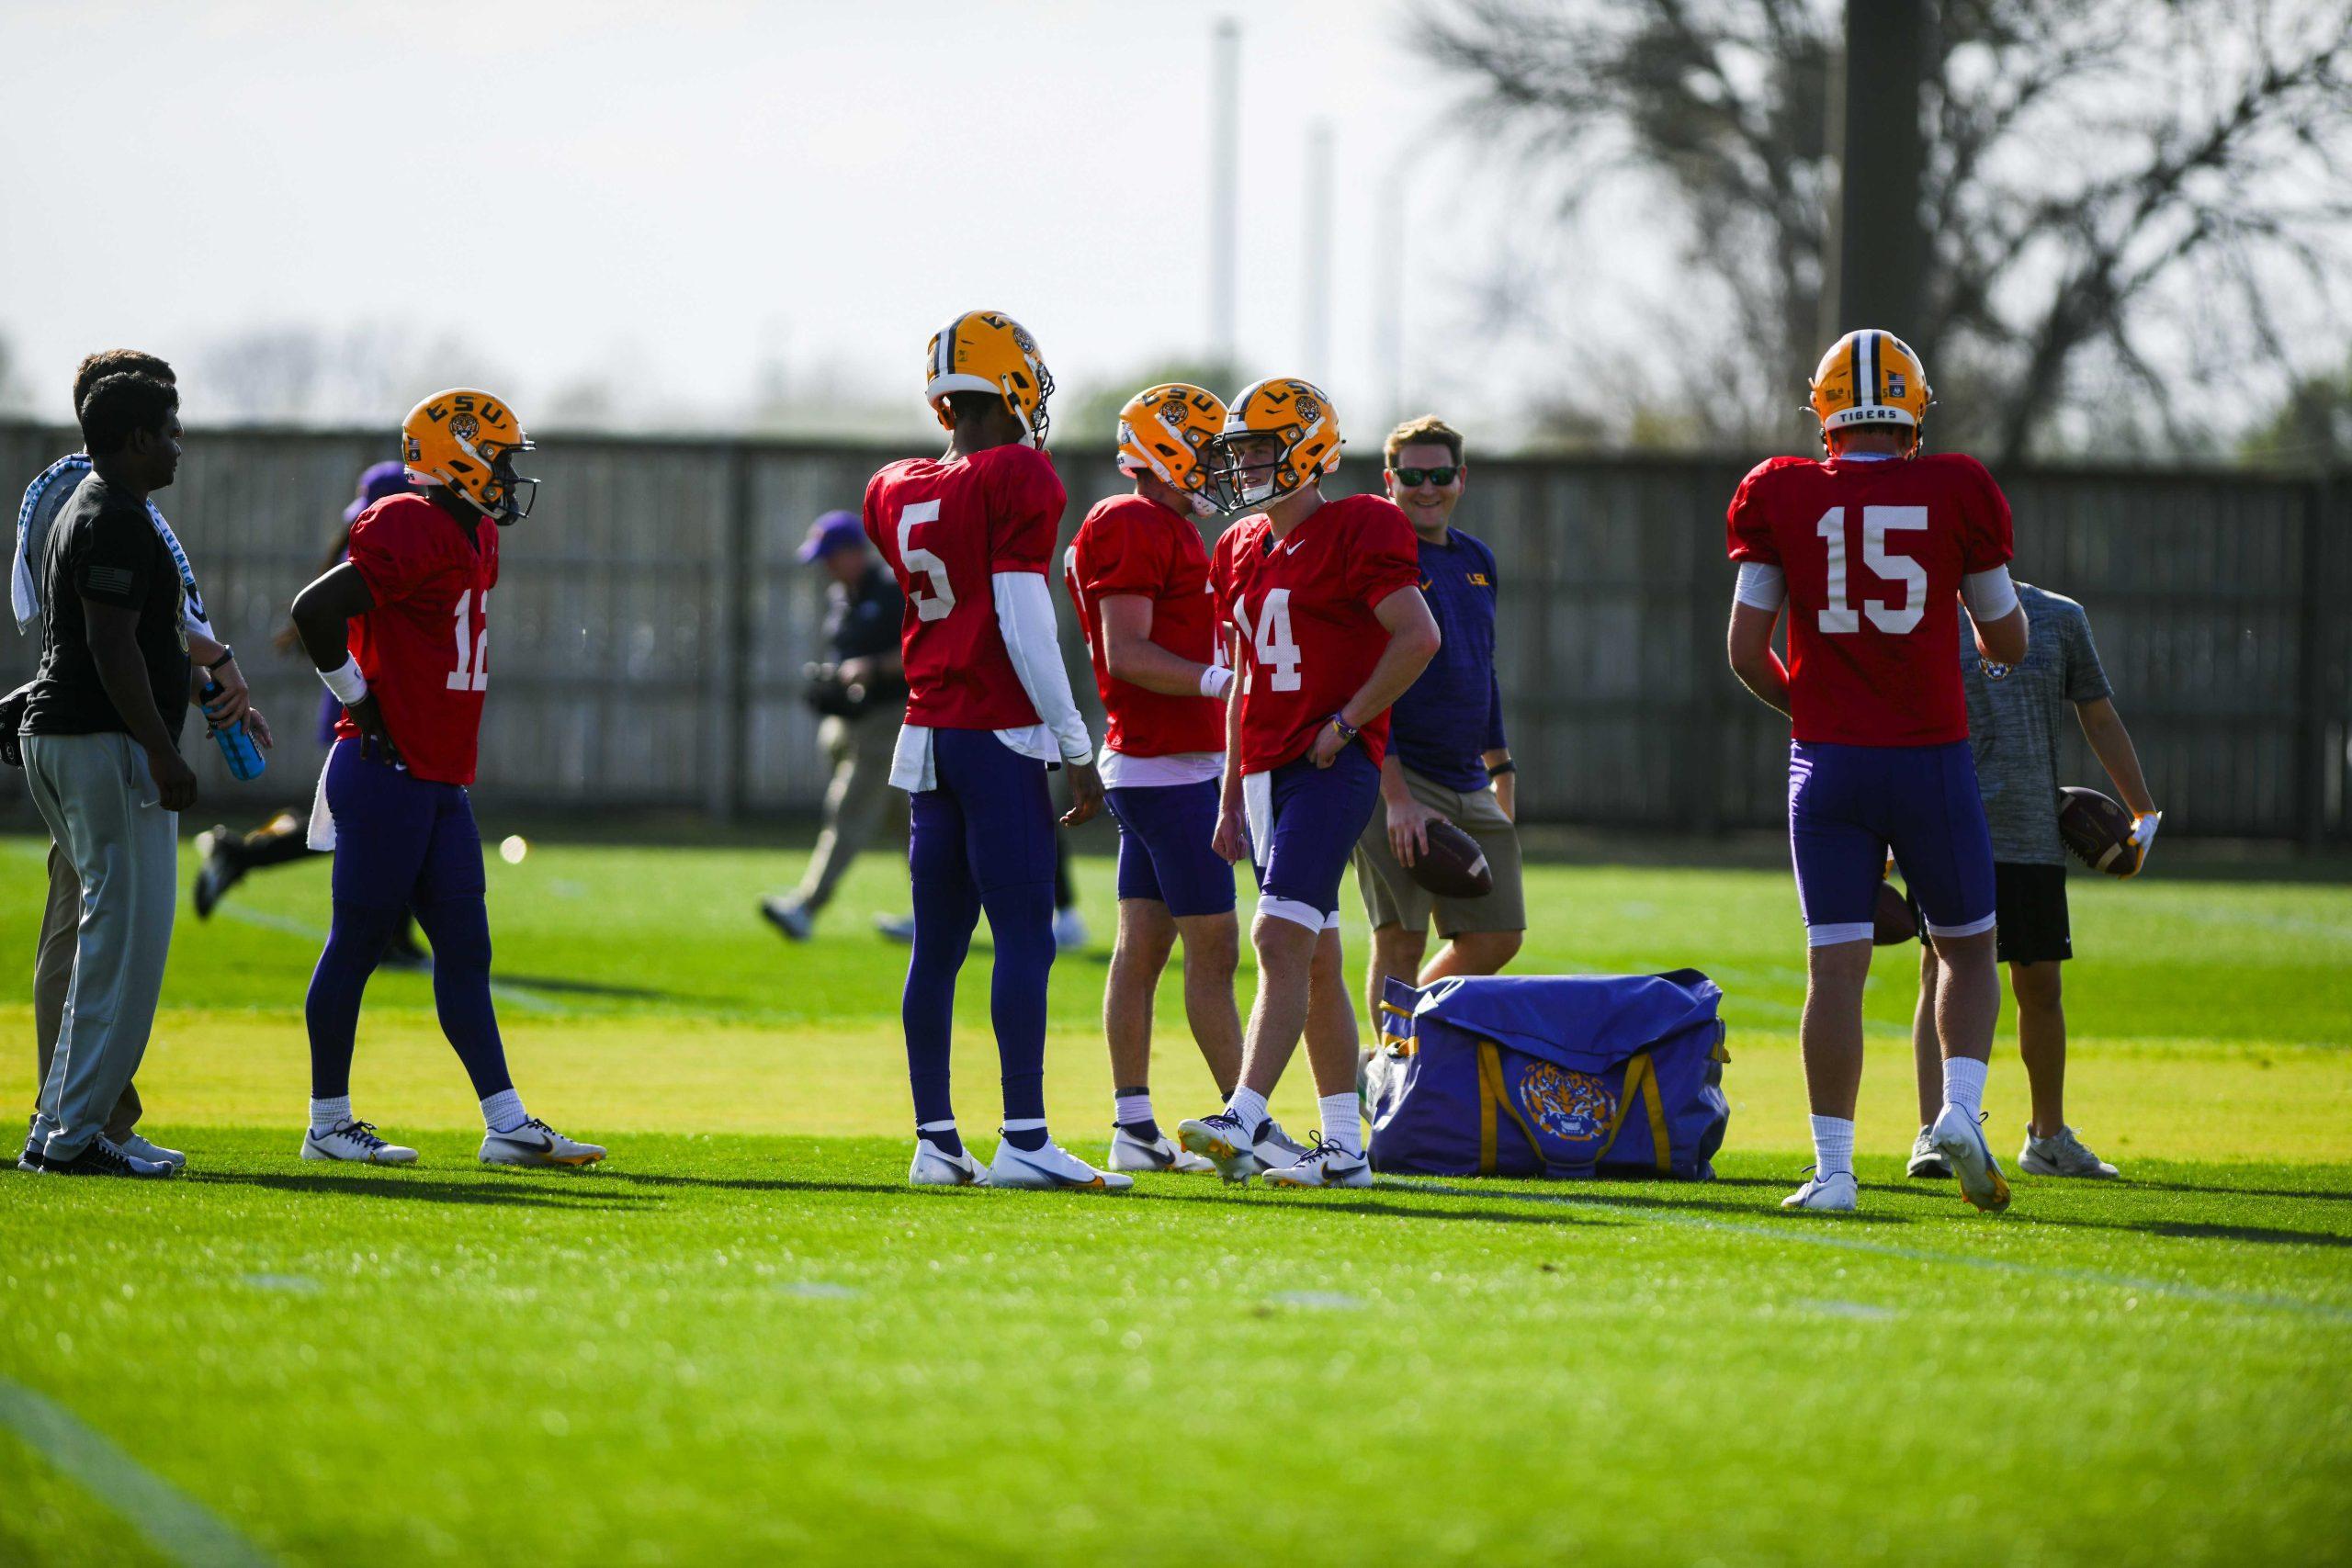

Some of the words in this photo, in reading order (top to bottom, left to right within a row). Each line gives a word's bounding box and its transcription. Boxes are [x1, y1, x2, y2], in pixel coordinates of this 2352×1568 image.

[425, 395, 503, 423] LSU
[1141, 388, 1214, 412] LSU
[1839, 409, 1897, 422] TIGERS
[897, 498, 956, 623] 5
[1816, 504, 1928, 635] 15
[1233, 587, 1302, 693] 14
